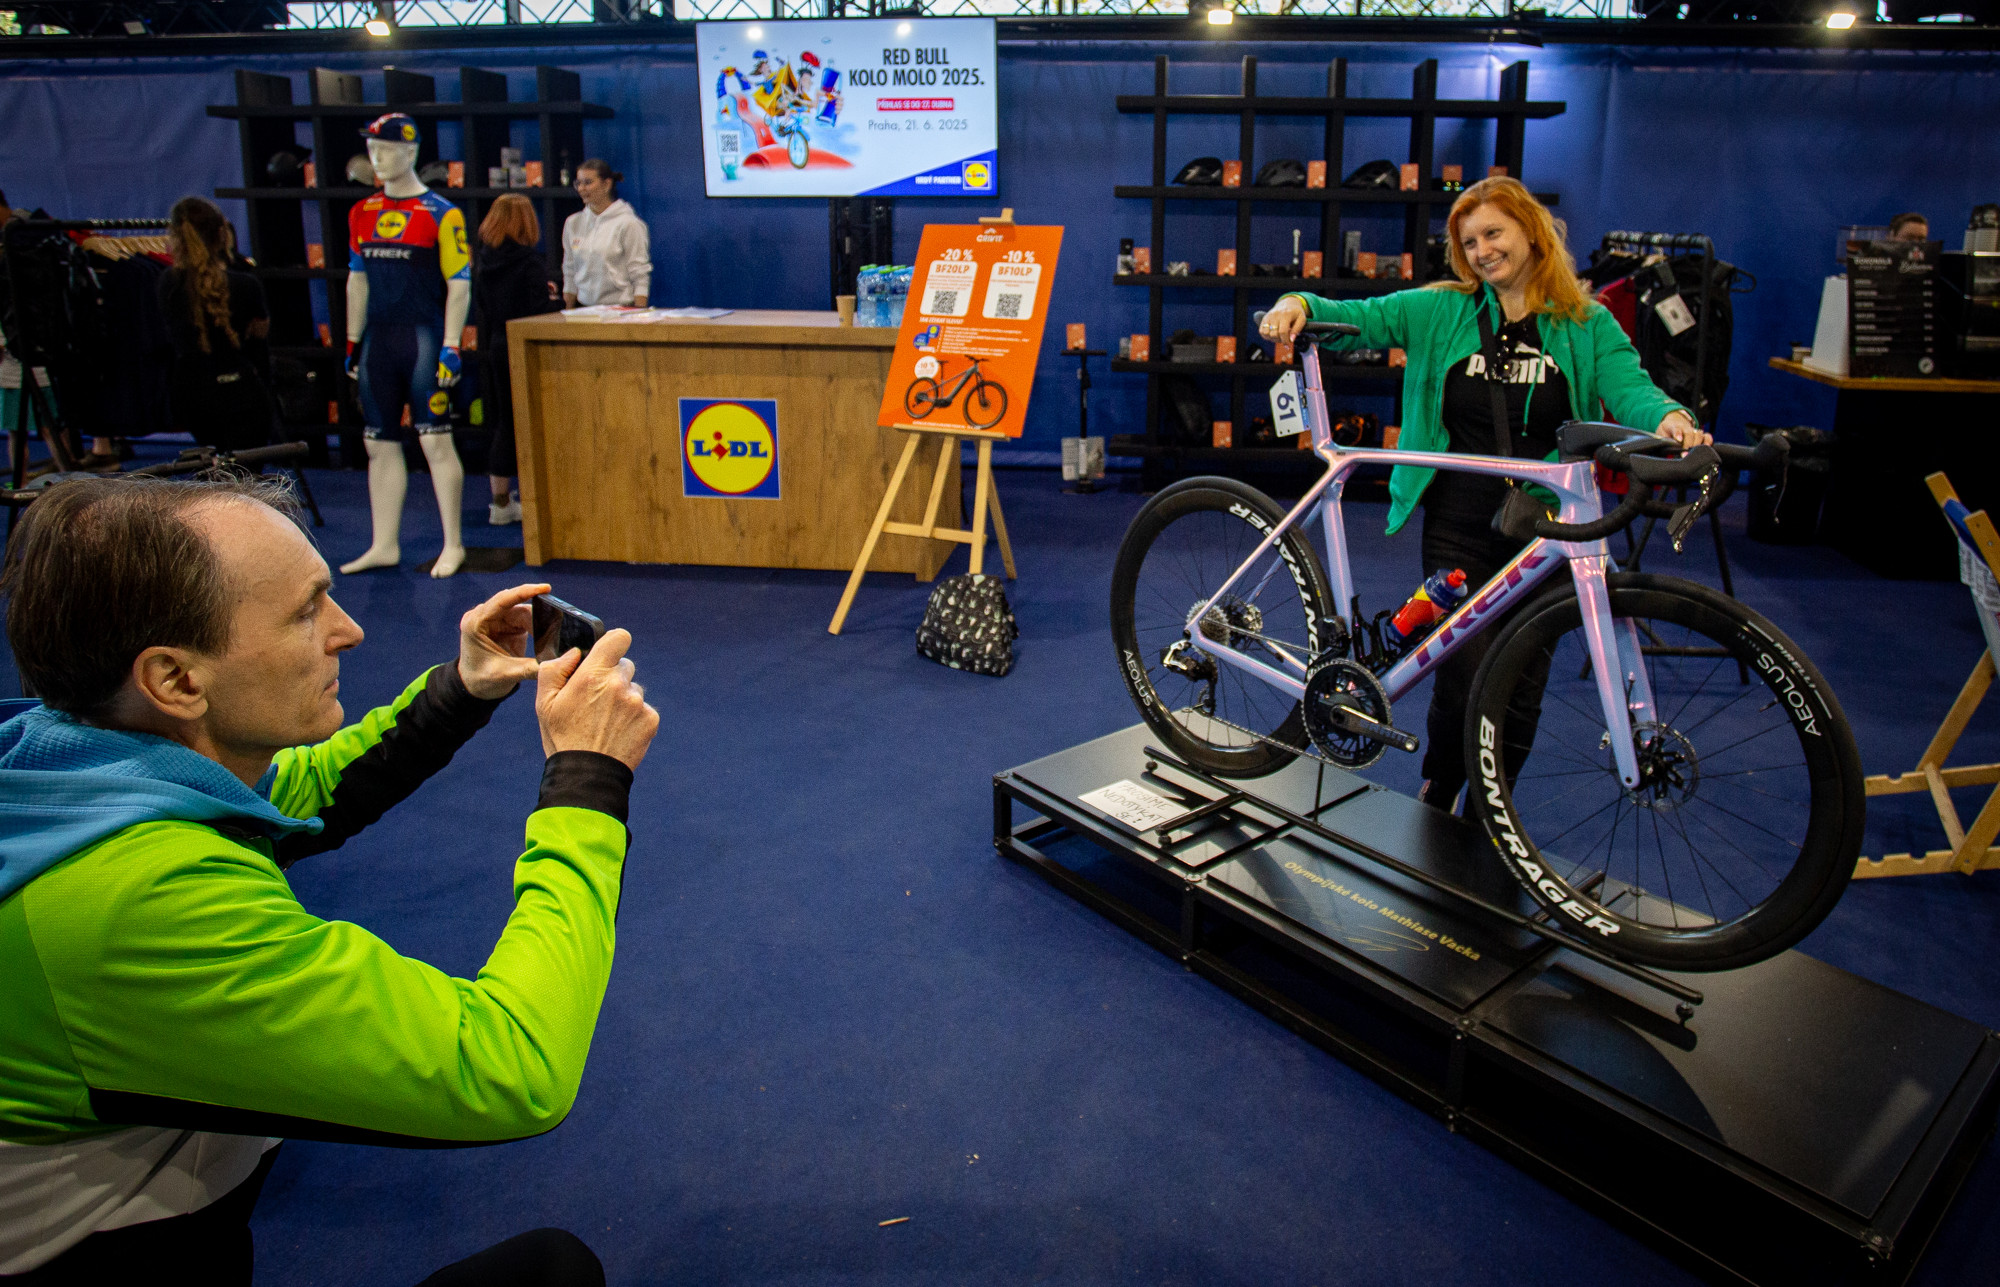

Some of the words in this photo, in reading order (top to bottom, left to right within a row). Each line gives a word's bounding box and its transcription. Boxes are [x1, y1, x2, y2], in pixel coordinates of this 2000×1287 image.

[883, 48, 910, 65] RED
[916, 48, 949, 65] BULL
[849, 68, 888, 86] KOLO
[891, 68, 938, 86] MOLO
[942, 68, 985, 85] 2025.
[868, 119, 901, 132] Praha,
[905, 119, 918, 130] 21.
[923, 119, 933, 130] 6.
[938, 119, 968, 130] 2025
[976, 234, 1004, 243] CRIVIT
[363, 247, 411, 260] TREK
[940, 248, 962, 261] -20
[963, 249, 974, 261] %
[1002, 250, 1023, 263] -10
[1024, 251, 1035, 263] %
[935, 264, 970, 274] BF20LP
[998, 266, 1032, 276] BF10LP
[1466, 353, 1546, 384] PMA
[1277, 392, 1297, 421] 61
[692, 431, 768, 462] LIDL
[1405, 547, 1550, 668] TREK
[1123, 649, 1153, 707] AEOLUS
[1757, 652, 1822, 737] AEOLUS
[1478, 714, 1621, 938] BONTRAGER
[1284, 861, 1352, 897] Olympijské
[1350, 893, 1379, 911] kolo
[1378, 906, 1439, 940] Mathiase
[1439, 934, 1481, 961] Vacka
